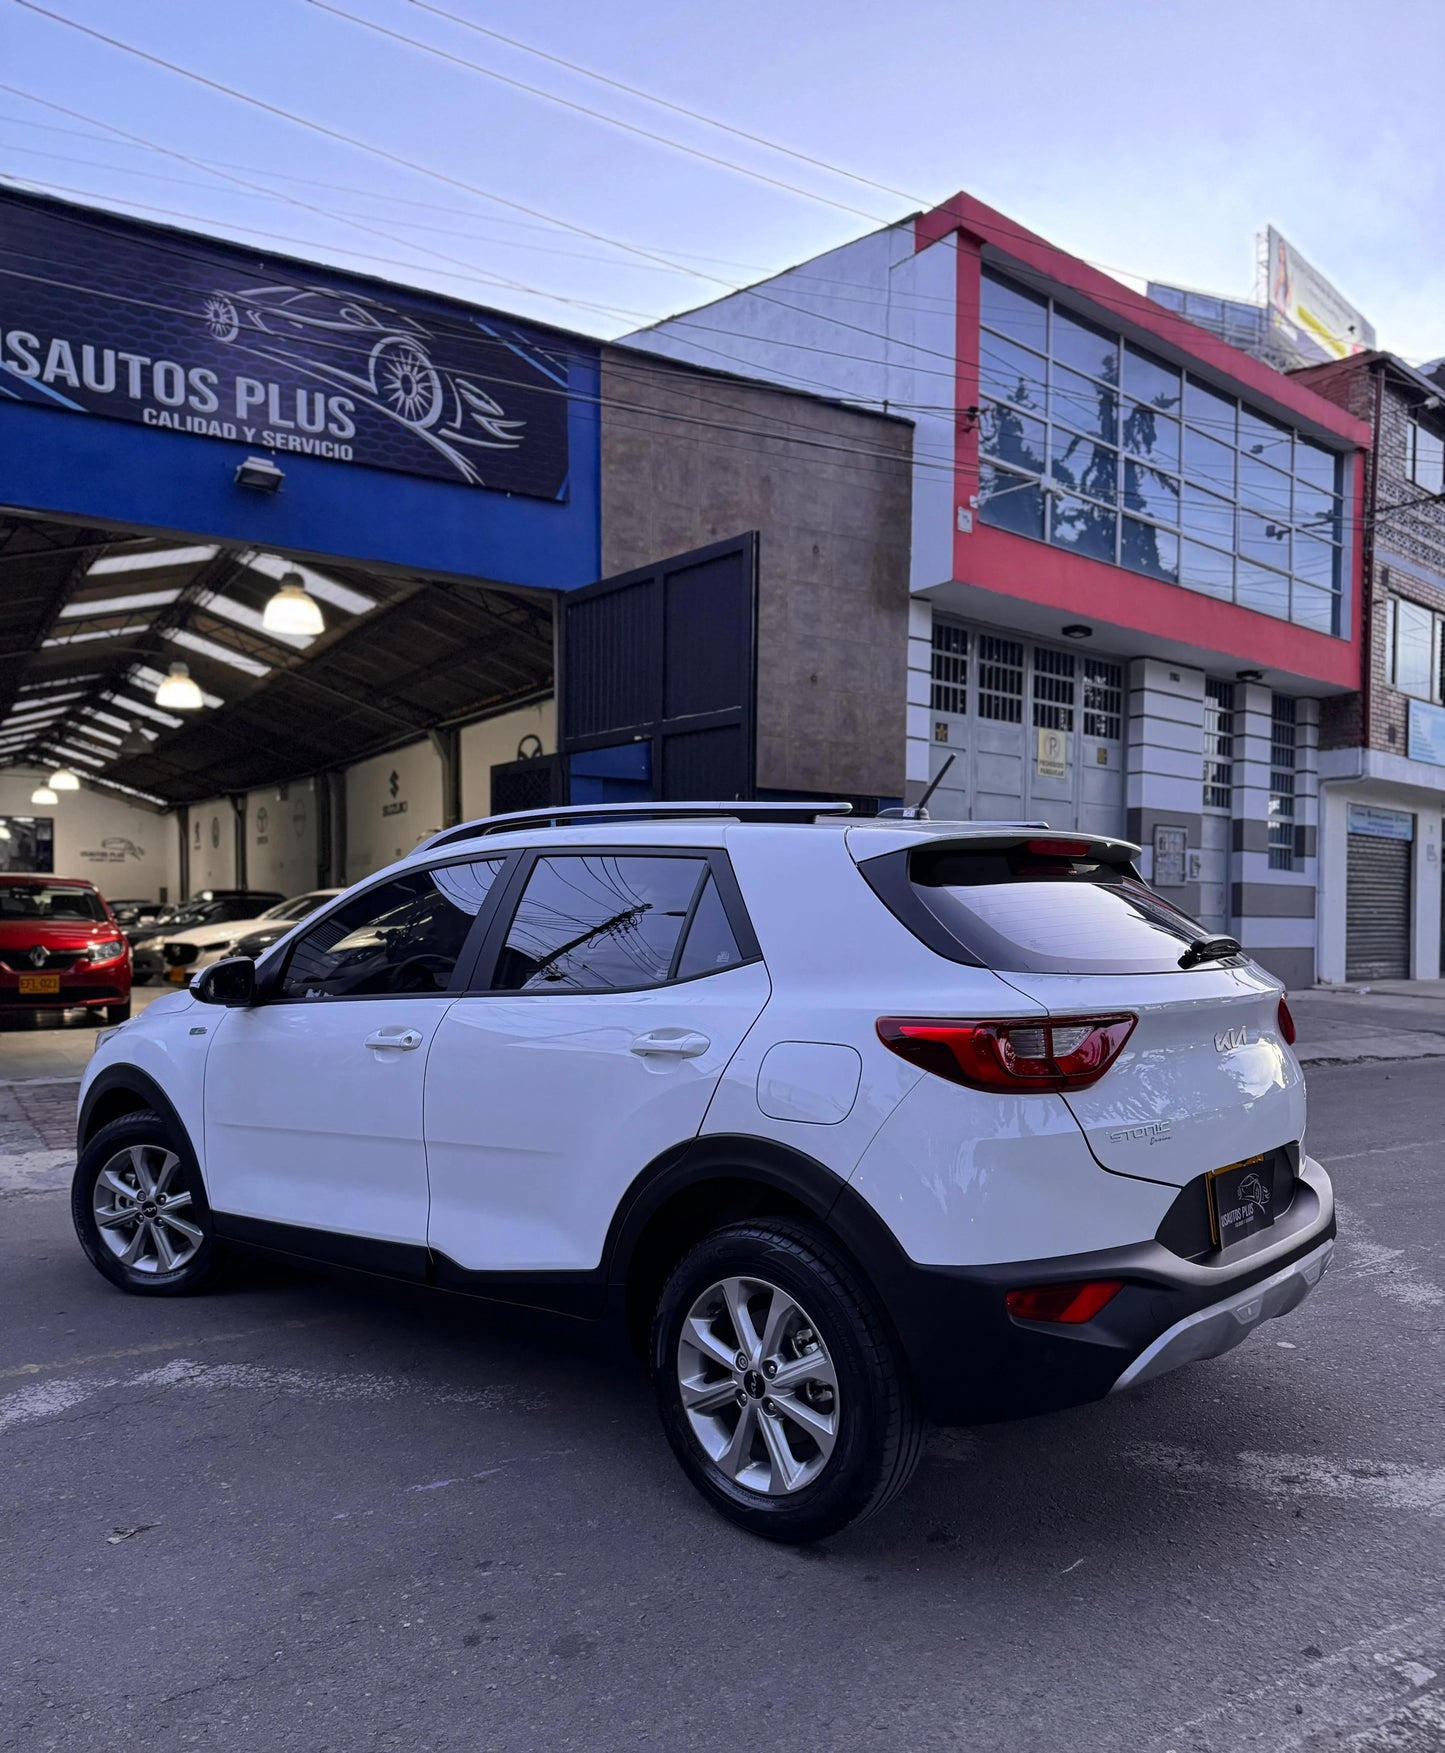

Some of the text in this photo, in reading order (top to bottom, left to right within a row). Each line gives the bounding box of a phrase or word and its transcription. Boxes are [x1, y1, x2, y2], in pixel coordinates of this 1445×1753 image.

[0, 327, 356, 439] SAUTOS PLUS
[142, 407, 353, 461] CALIDAD Y SERVICIO
[1213, 1024, 1247, 1053] KIA
[1110, 1121, 1170, 1144] STONIC
[1241, 1202, 1254, 1219] PLUS
